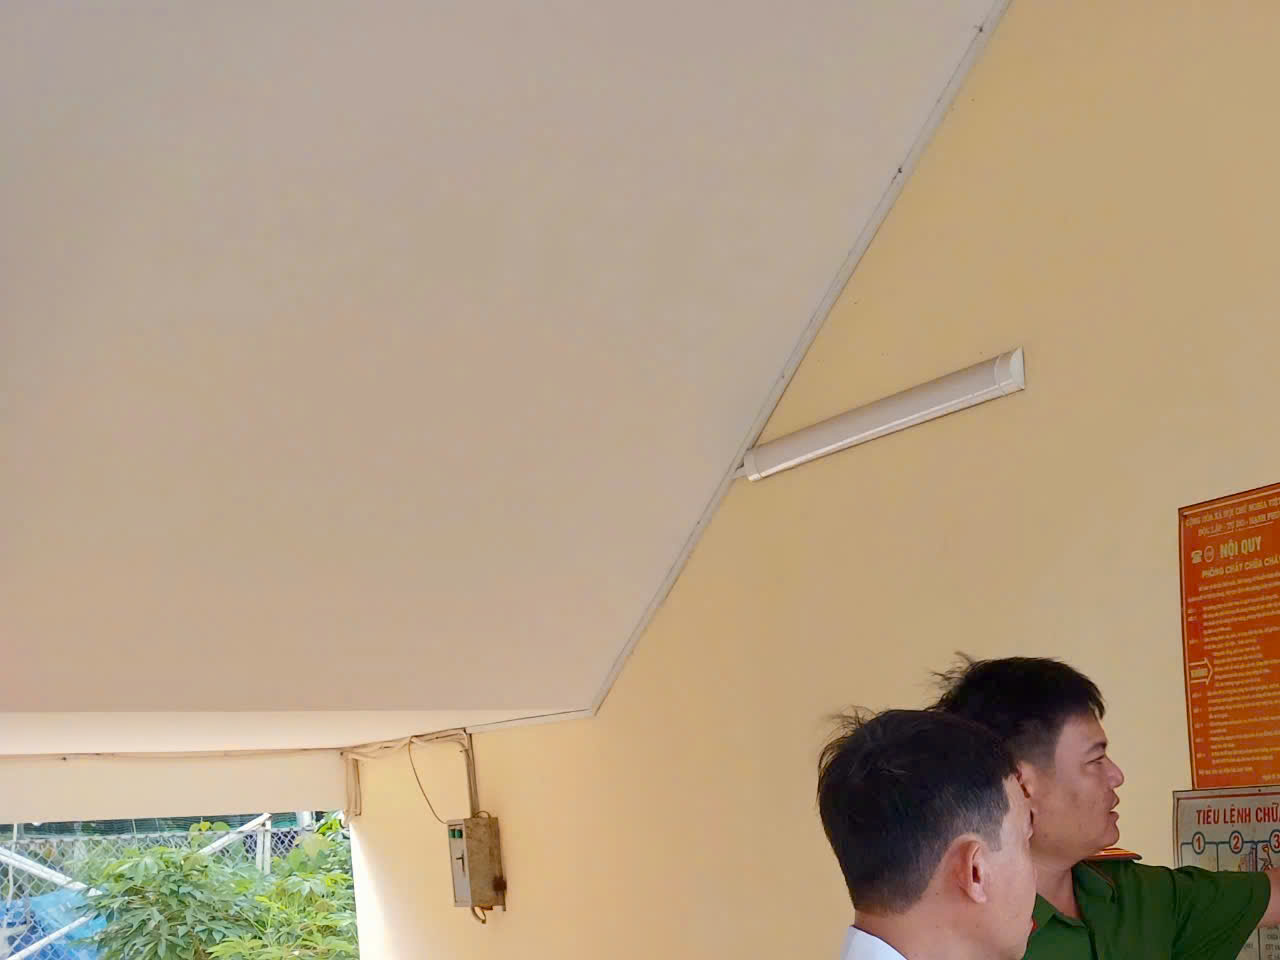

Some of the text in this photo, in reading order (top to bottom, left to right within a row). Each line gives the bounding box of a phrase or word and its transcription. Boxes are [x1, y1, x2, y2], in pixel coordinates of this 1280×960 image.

[1220, 538, 1239, 560] NỘI
[1241, 536, 1262, 555] QUY
[1225, 560, 1244, 574] CHÁY
[1196, 804, 1220, 825] TIÊU
[1223, 803, 1252, 828] LỆNH
[1196, 836, 1201, 850] 1
[1233, 835, 1240, 850] 2
[1273, 834, 1280, 849] 3
